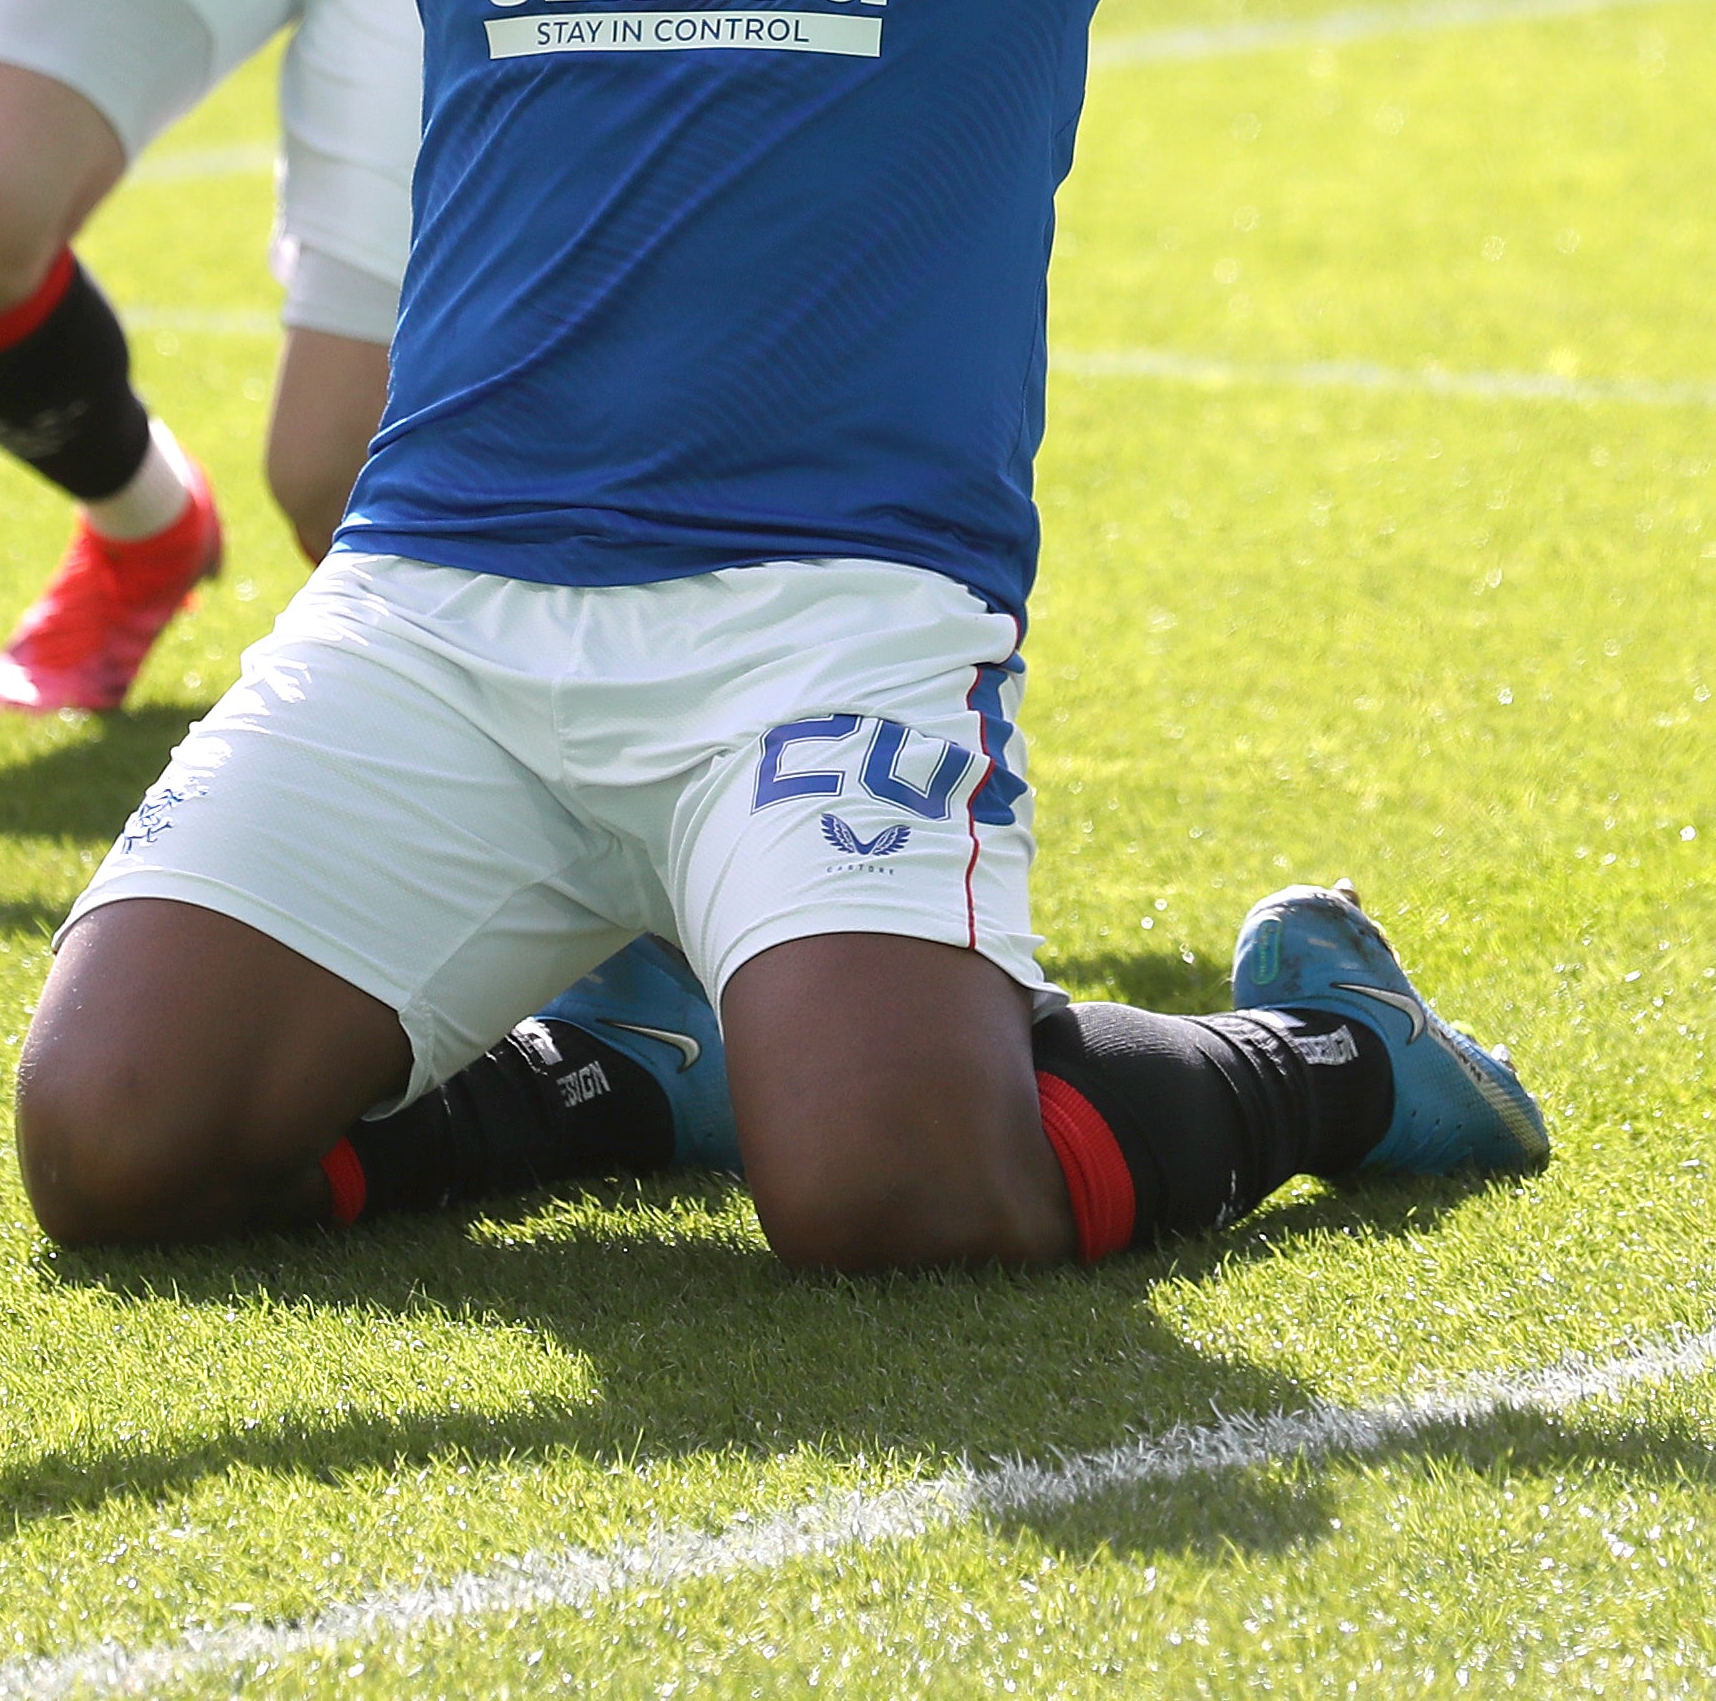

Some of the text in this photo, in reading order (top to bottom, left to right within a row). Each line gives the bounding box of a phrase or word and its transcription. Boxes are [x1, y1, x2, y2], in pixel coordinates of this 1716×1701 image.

[536, 18, 810, 46] STAY IN CONTROL
[751, 714, 976, 822] 20
[825, 862, 895, 877] CASTORE
